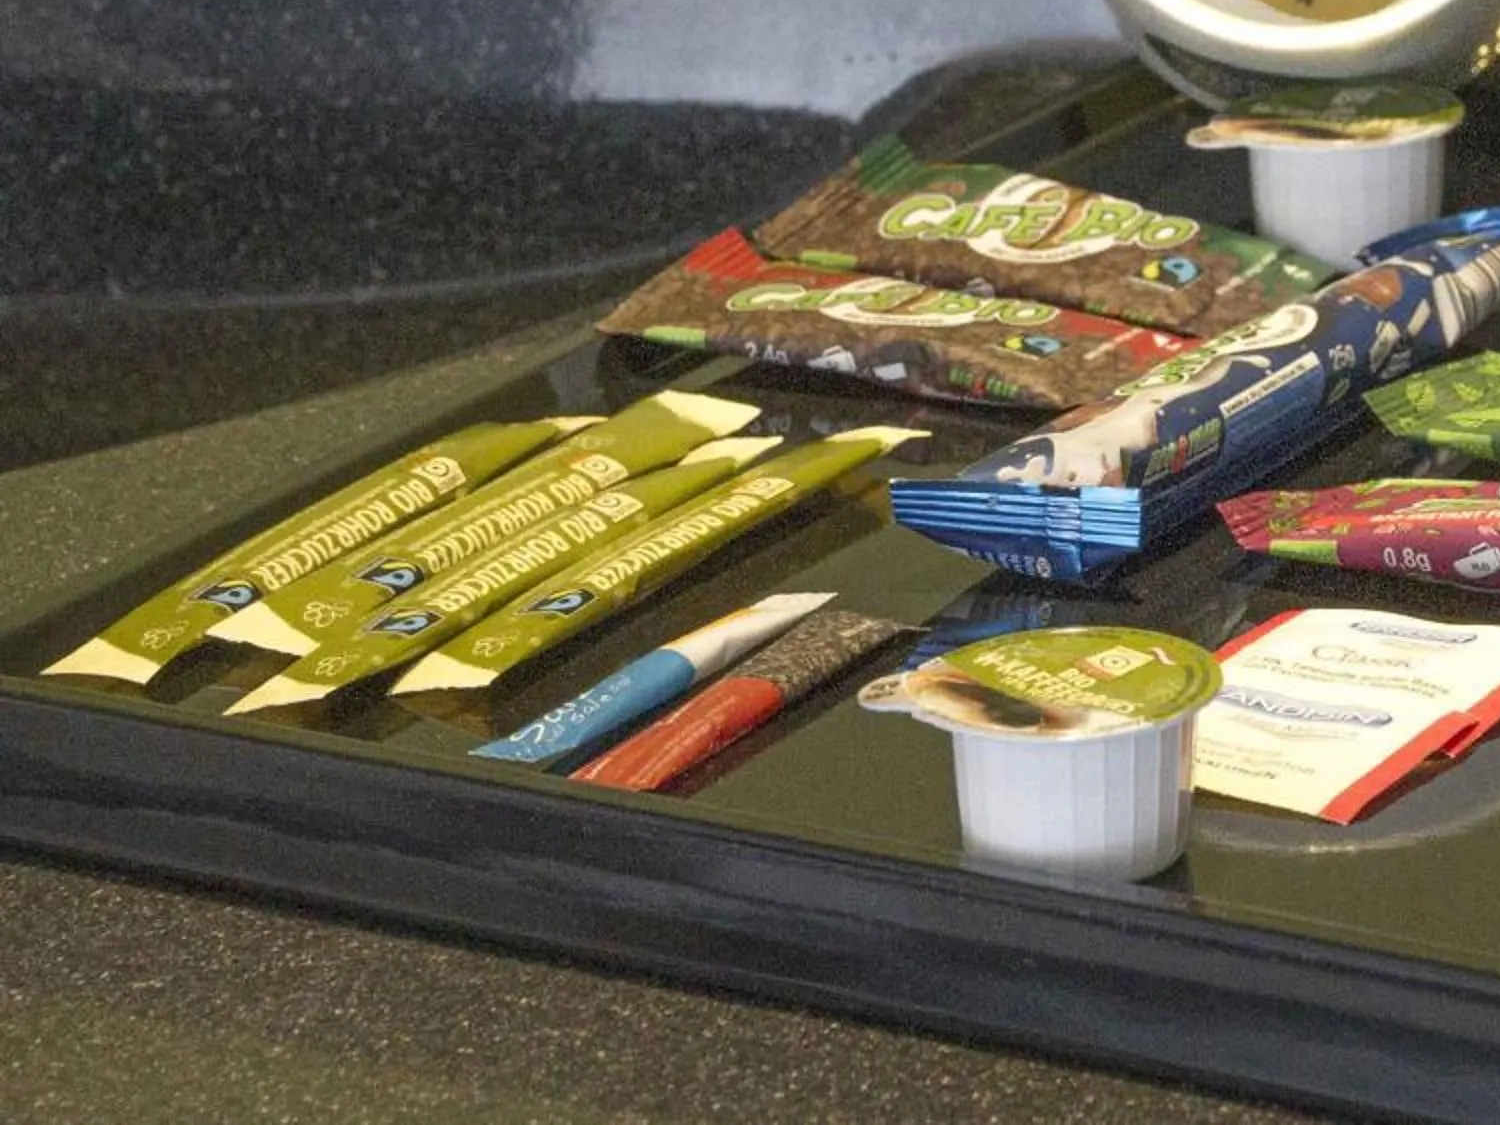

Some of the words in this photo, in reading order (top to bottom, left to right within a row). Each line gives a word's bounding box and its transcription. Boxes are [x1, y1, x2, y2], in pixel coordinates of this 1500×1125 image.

[1068, 191, 1199, 248] BIO
[387, 478, 435, 514] BIO
[549, 473, 595, 506] BIO
[710, 493, 762, 518] BIO
[256, 500, 397, 592] ROHRZUCKER
[415, 490, 556, 574] ROHRZUCKER
[559, 509, 608, 544] BIO
[425, 530, 572, 612] ROHRZUCKER
[585, 513, 725, 591] ROHRZUCKER
[1382, 546, 1432, 572] 0,8g
